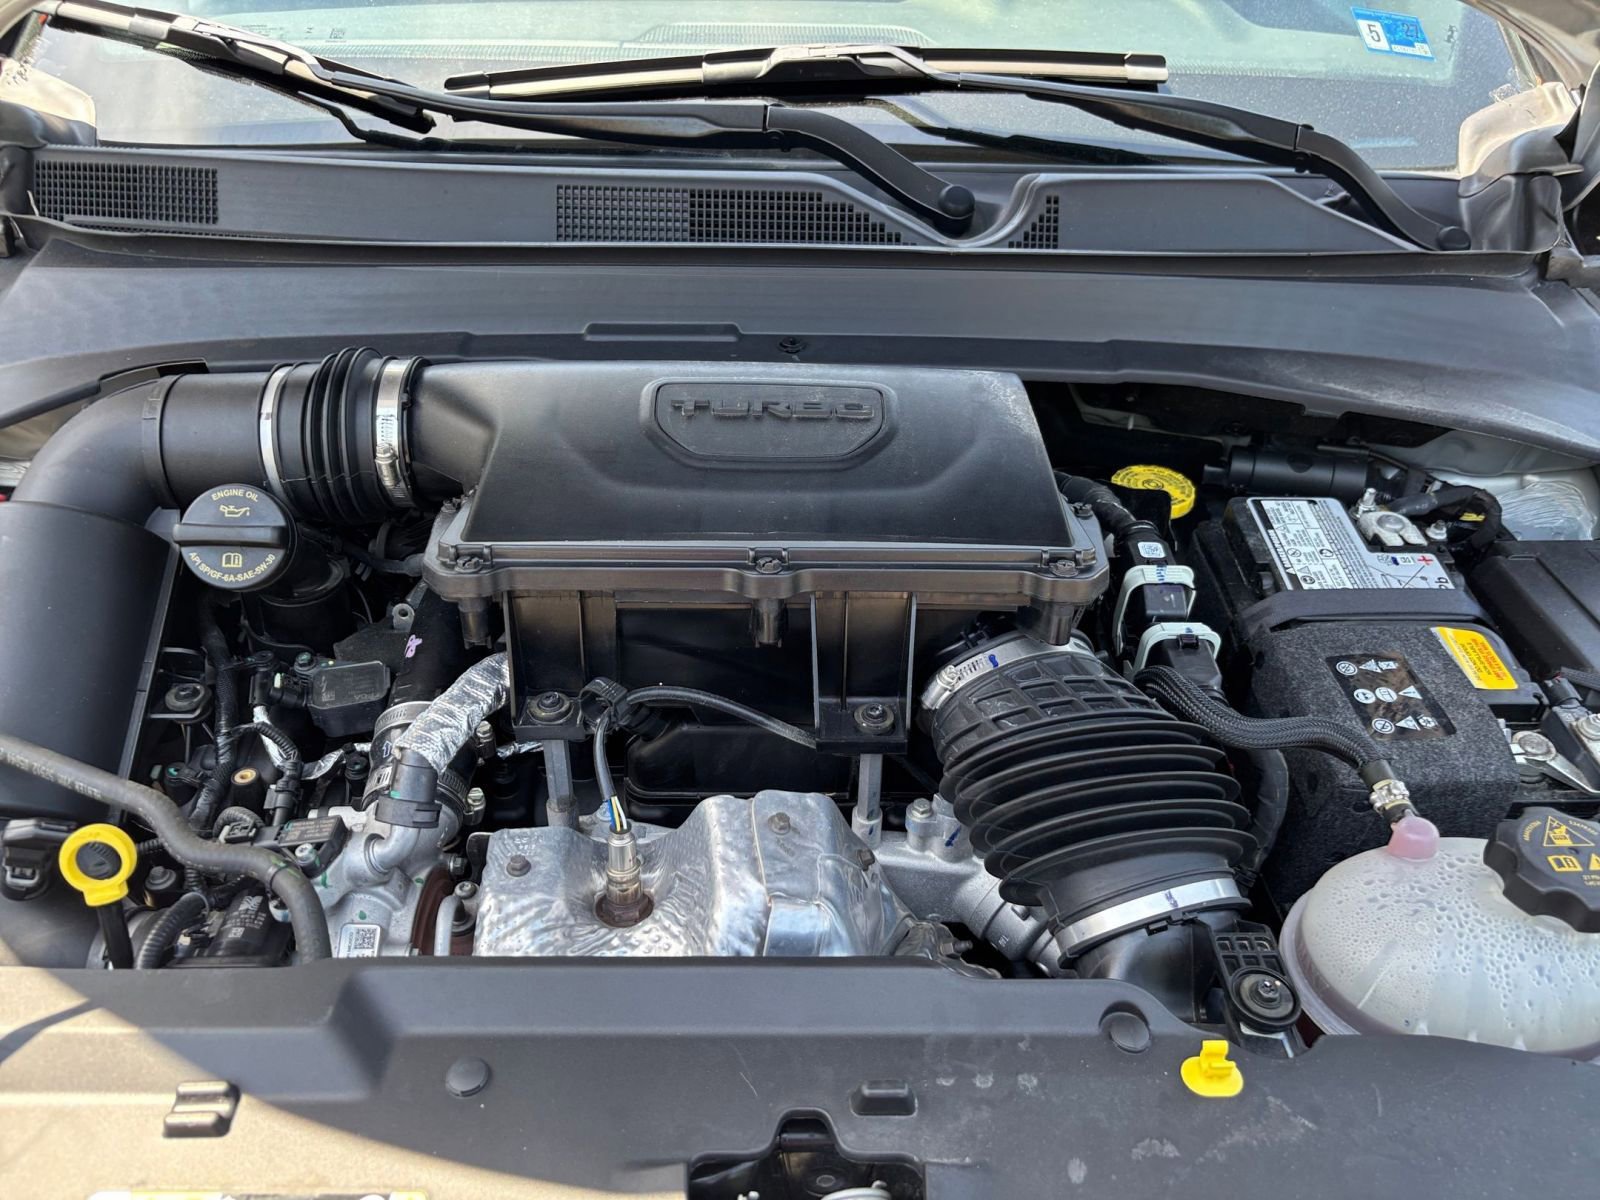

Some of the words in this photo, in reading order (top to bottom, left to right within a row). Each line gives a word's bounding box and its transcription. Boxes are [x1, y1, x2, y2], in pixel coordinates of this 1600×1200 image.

[1367, 23, 1381, 42] 5
[670, 399, 875, 421] TURBO
[211, 488, 245, 501] ENGINE
[245, 490, 259, 502] OIL
[188, 551, 202, 566] API
